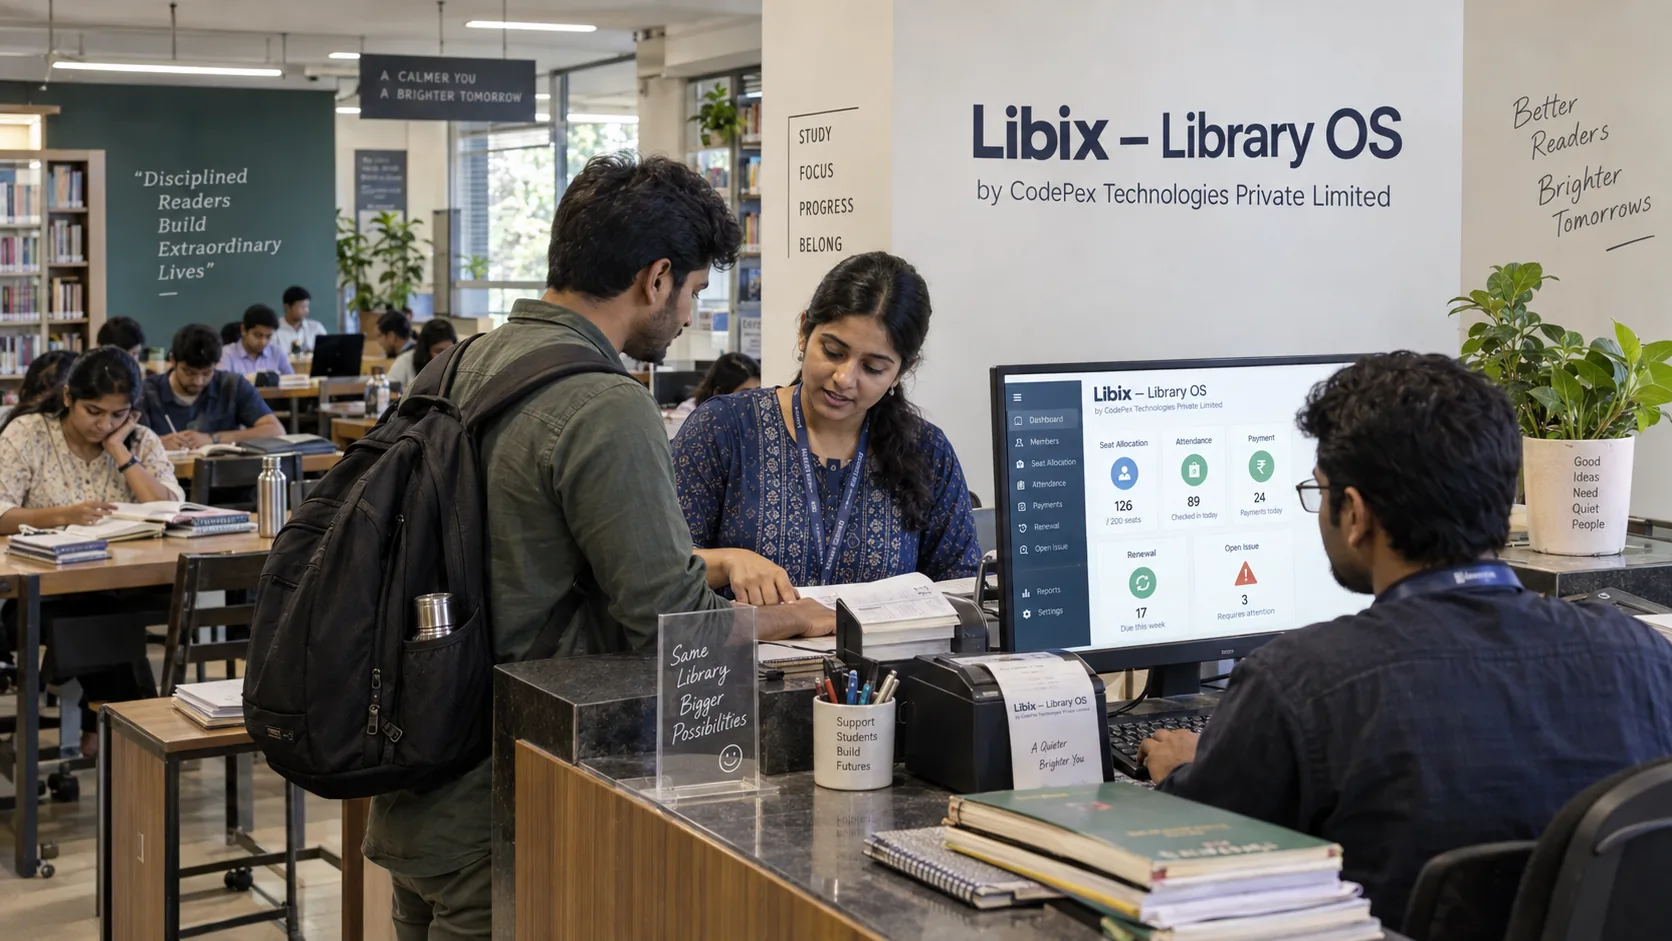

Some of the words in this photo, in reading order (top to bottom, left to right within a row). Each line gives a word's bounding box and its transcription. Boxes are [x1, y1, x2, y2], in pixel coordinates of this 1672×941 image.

[380, 70, 389, 81] A
[398, 71, 449, 83] CALMER
[454, 73, 476, 84] YOU
[380, 88, 388, 99] A
[397, 88, 454, 101] BRIGHTER
[460, 91, 522, 103] TOMORROW
[1513, 94, 1578, 129] Better
[799, 126, 832, 144] STUDY
[973, 104, 1110, 160] Libix
[1163, 111, 1315, 169] Library
[1326, 106, 1403, 160] OS
[1531, 121, 1609, 160] Readers
[800, 163, 834, 181] FOCUS
[1538, 165, 1622, 206] Brighter
[977, 179, 1003, 206] by
[1010, 181, 1096, 203] CodePex
[1103, 182, 1229, 210] Technologies
[1236, 184, 1305, 206] Private
[1313, 185, 1391, 207] Limited
[158, 193, 231, 210] Readers
[799, 198, 854, 217] PROGRESS
[1552, 196, 1651, 237] Tomorrows
[158, 216, 206, 233] Build
[158, 238, 281, 257] Extraordinary
[799, 236, 842, 252] BELONG
[1093, 385, 1132, 402] Libix
[1147, 386, 1187, 400] Library
[1190, 384, 1207, 397] OS
[1094, 407, 1104, 416] by
[1104, 407, 1133, 415] CodePex
[1134, 404, 1176, 413] Technologies
[1176, 402, 1199, 410] Private
[1199, 400, 1223, 409] Limited
[1029, 416, 1064, 424] Dashboard
[1030, 438, 1060, 446] Members
[1099, 441, 1115, 449] Seat
[1116, 439, 1149, 448] Allocation
[1176, 437, 1212, 446] Attendance
[1248, 434, 1275, 443] Payment
[1031, 459, 1046, 468] Seat
[1047, 458, 1077, 467] Allocation
[1574, 456, 1601, 467] Good
[1573, 472, 1600, 482] Ideas
[1032, 480, 1067, 488] Attendance
[1254, 492, 1266, 503] 24
[1573, 487, 1599, 498] Need
[1033, 501, 1063, 511] Payments
[1114, 500, 1133, 512] 126
[1187, 496, 1201, 507] 89
[1240, 510, 1267, 518] Payments
[1267, 507, 1283, 517] today
[1572, 503, 1600, 515] Quiet
[1110, 518, 1123, 526] 200
[1124, 516, 1142, 524] seats
[1202, 511, 1218, 521] today
[1034, 522, 1060, 531] Renewal
[1572, 519, 1605, 531] People
[1035, 544, 1052, 554] Open
[1052, 543, 1068, 551] Issue
[1225, 543, 1242, 552] Open
[1242, 542, 1260, 551] Issue
[1127, 549, 1157, 559] Renewal
[1037, 587, 1061, 595] Reports
[1241, 594, 1249, 606] 3
[1038, 607, 1063, 616] Settings
[1135, 607, 1147, 619] 17
[1217, 610, 1246, 621] Requires
[1246, 608, 1276, 617] attention
[1120, 623, 1135, 633] Due
[1135, 623, 1148, 631] this
[1148, 620, 1166, 630] week
[670, 644, 709, 667] Same
[677, 665, 731, 688] Library
[680, 693, 725, 719] Bigger
[1014, 701, 1037, 712] Libix
[1046, 699, 1074, 709] Library
[1074, 696, 1088, 705] OS
[672, 712, 747, 745] Possibilities
[837, 716, 875, 730] Support
[837, 732, 878, 742] Students
[837, 746, 860, 757] Build
[1030, 742, 1038, 754] A
[1040, 740, 1068, 753] Quieter
[836, 760, 871, 771] Futures
[1039, 757, 1070, 772] Brighter
[1071, 753, 1085, 767] You
